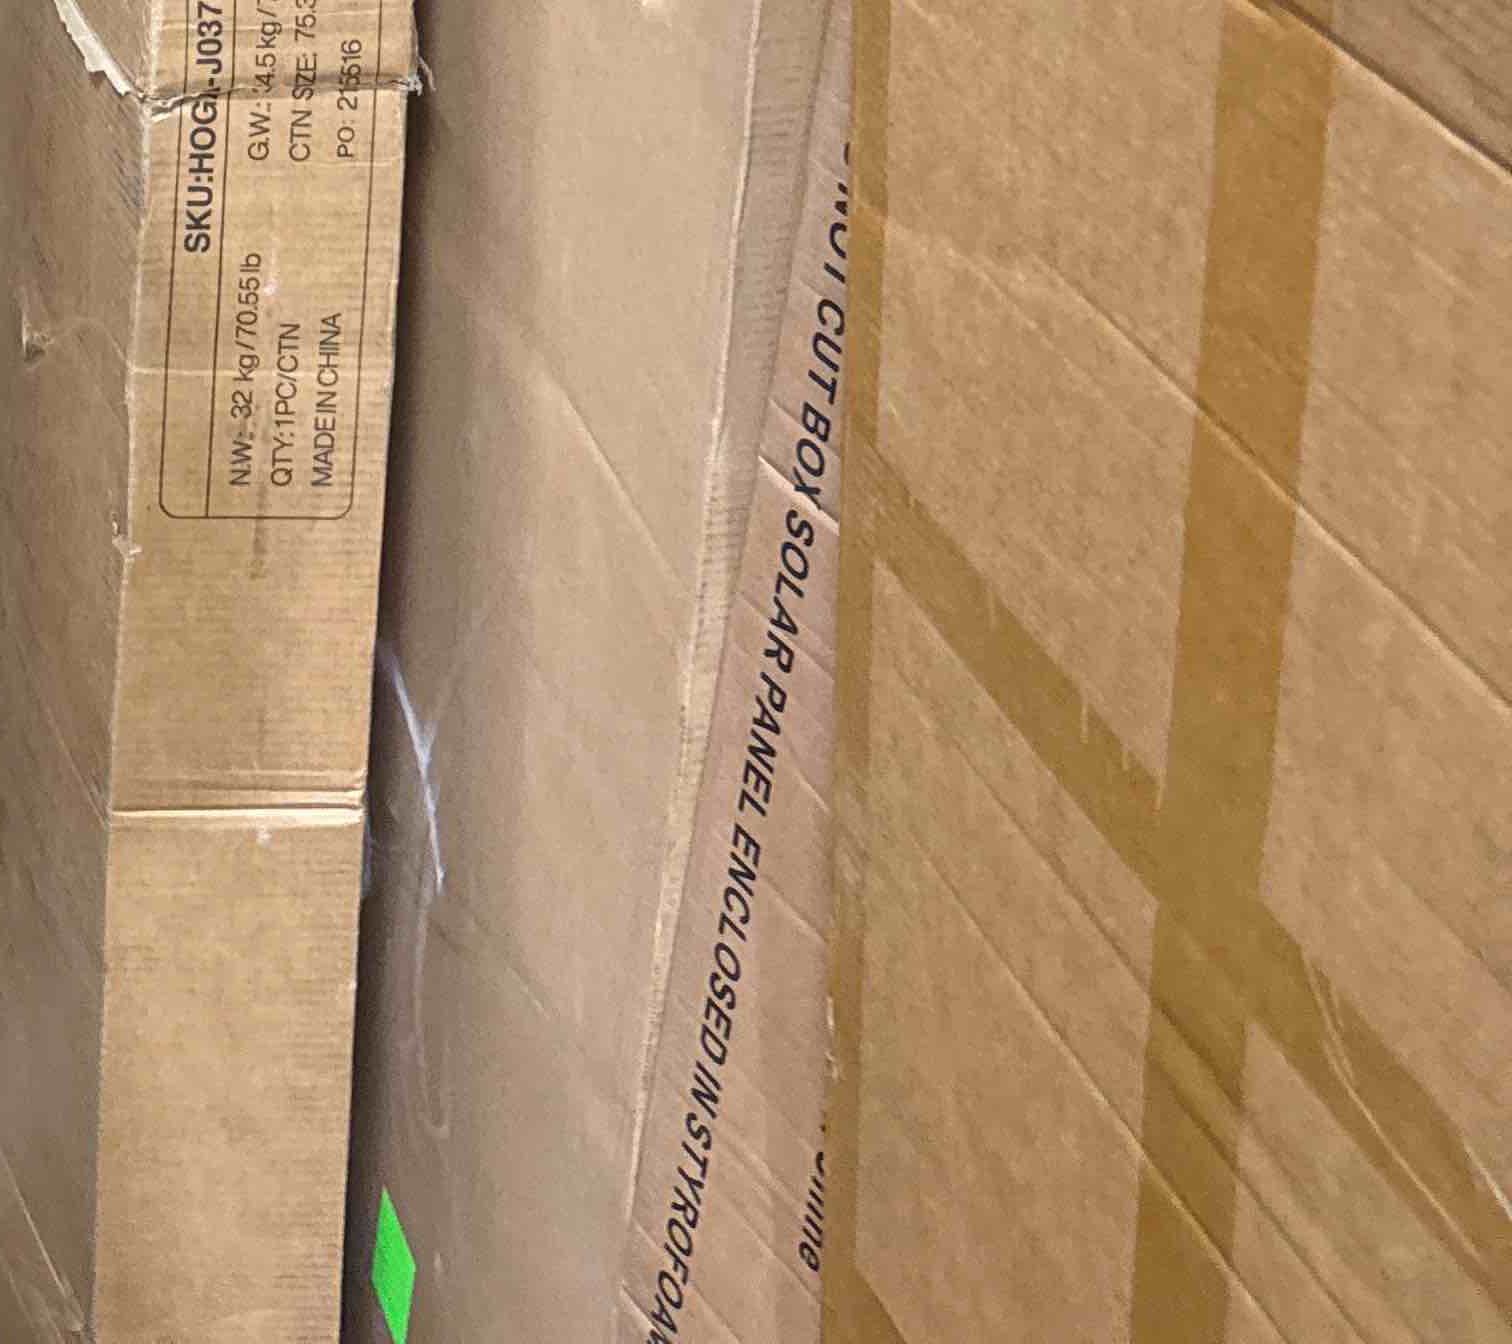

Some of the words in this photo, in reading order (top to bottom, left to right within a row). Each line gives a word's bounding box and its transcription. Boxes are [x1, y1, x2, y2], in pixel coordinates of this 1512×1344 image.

[288, 109, 314, 161] CTN
[336, 120, 357, 158] PO:
[315, 312, 342, 385] CHINA
[807, 297, 847, 406] CUT
[230, 391, 253, 419] 32
[793, 400, 832, 510] BOX
[760, 507, 816, 677] SOLAR
[738, 668, 789, 818] PANEL
[698, 820, 762, 1068] ENCLOSED
[688, 1060, 724, 1121] IN
